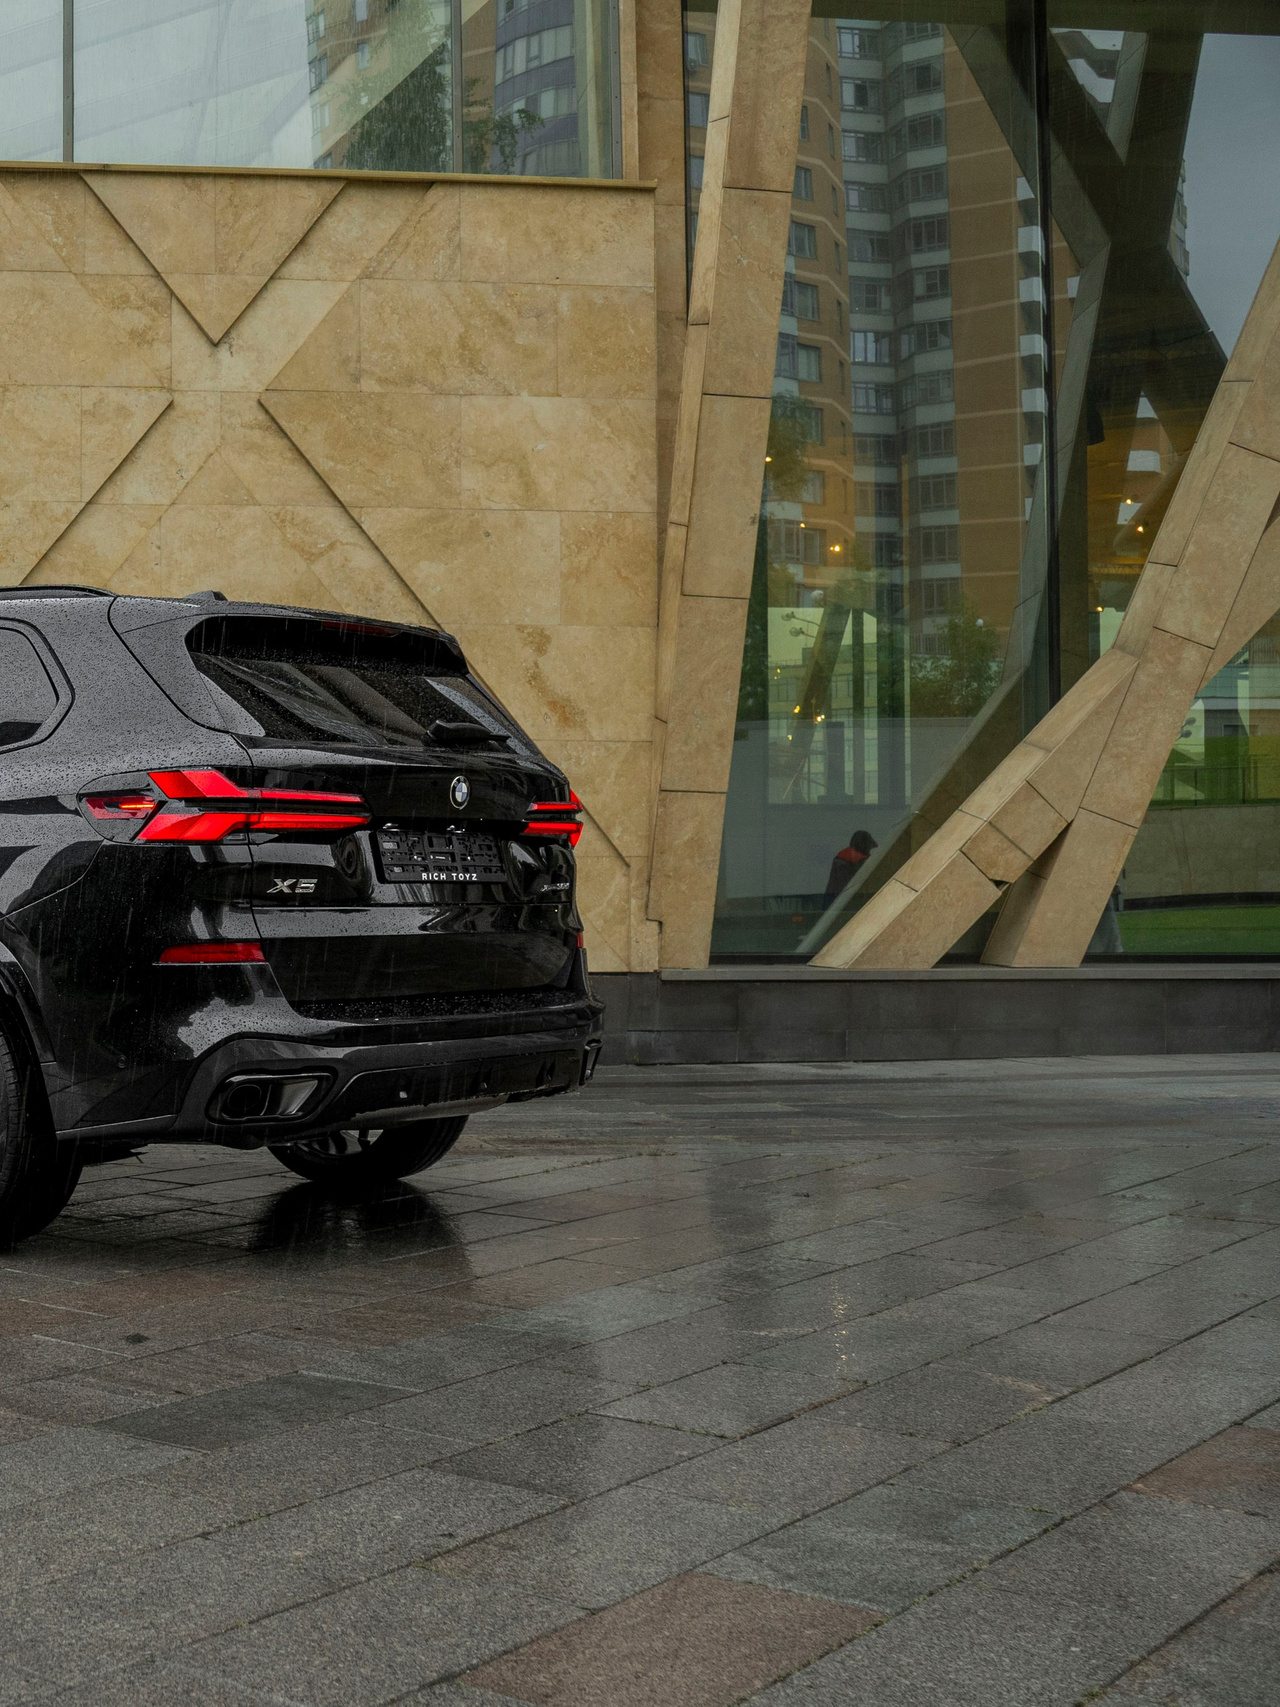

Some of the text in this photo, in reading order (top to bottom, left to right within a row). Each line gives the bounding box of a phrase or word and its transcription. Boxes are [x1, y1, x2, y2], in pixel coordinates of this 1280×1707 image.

[421, 872, 478, 881] RICH TOYZ
[266, 878, 318, 893] X5
